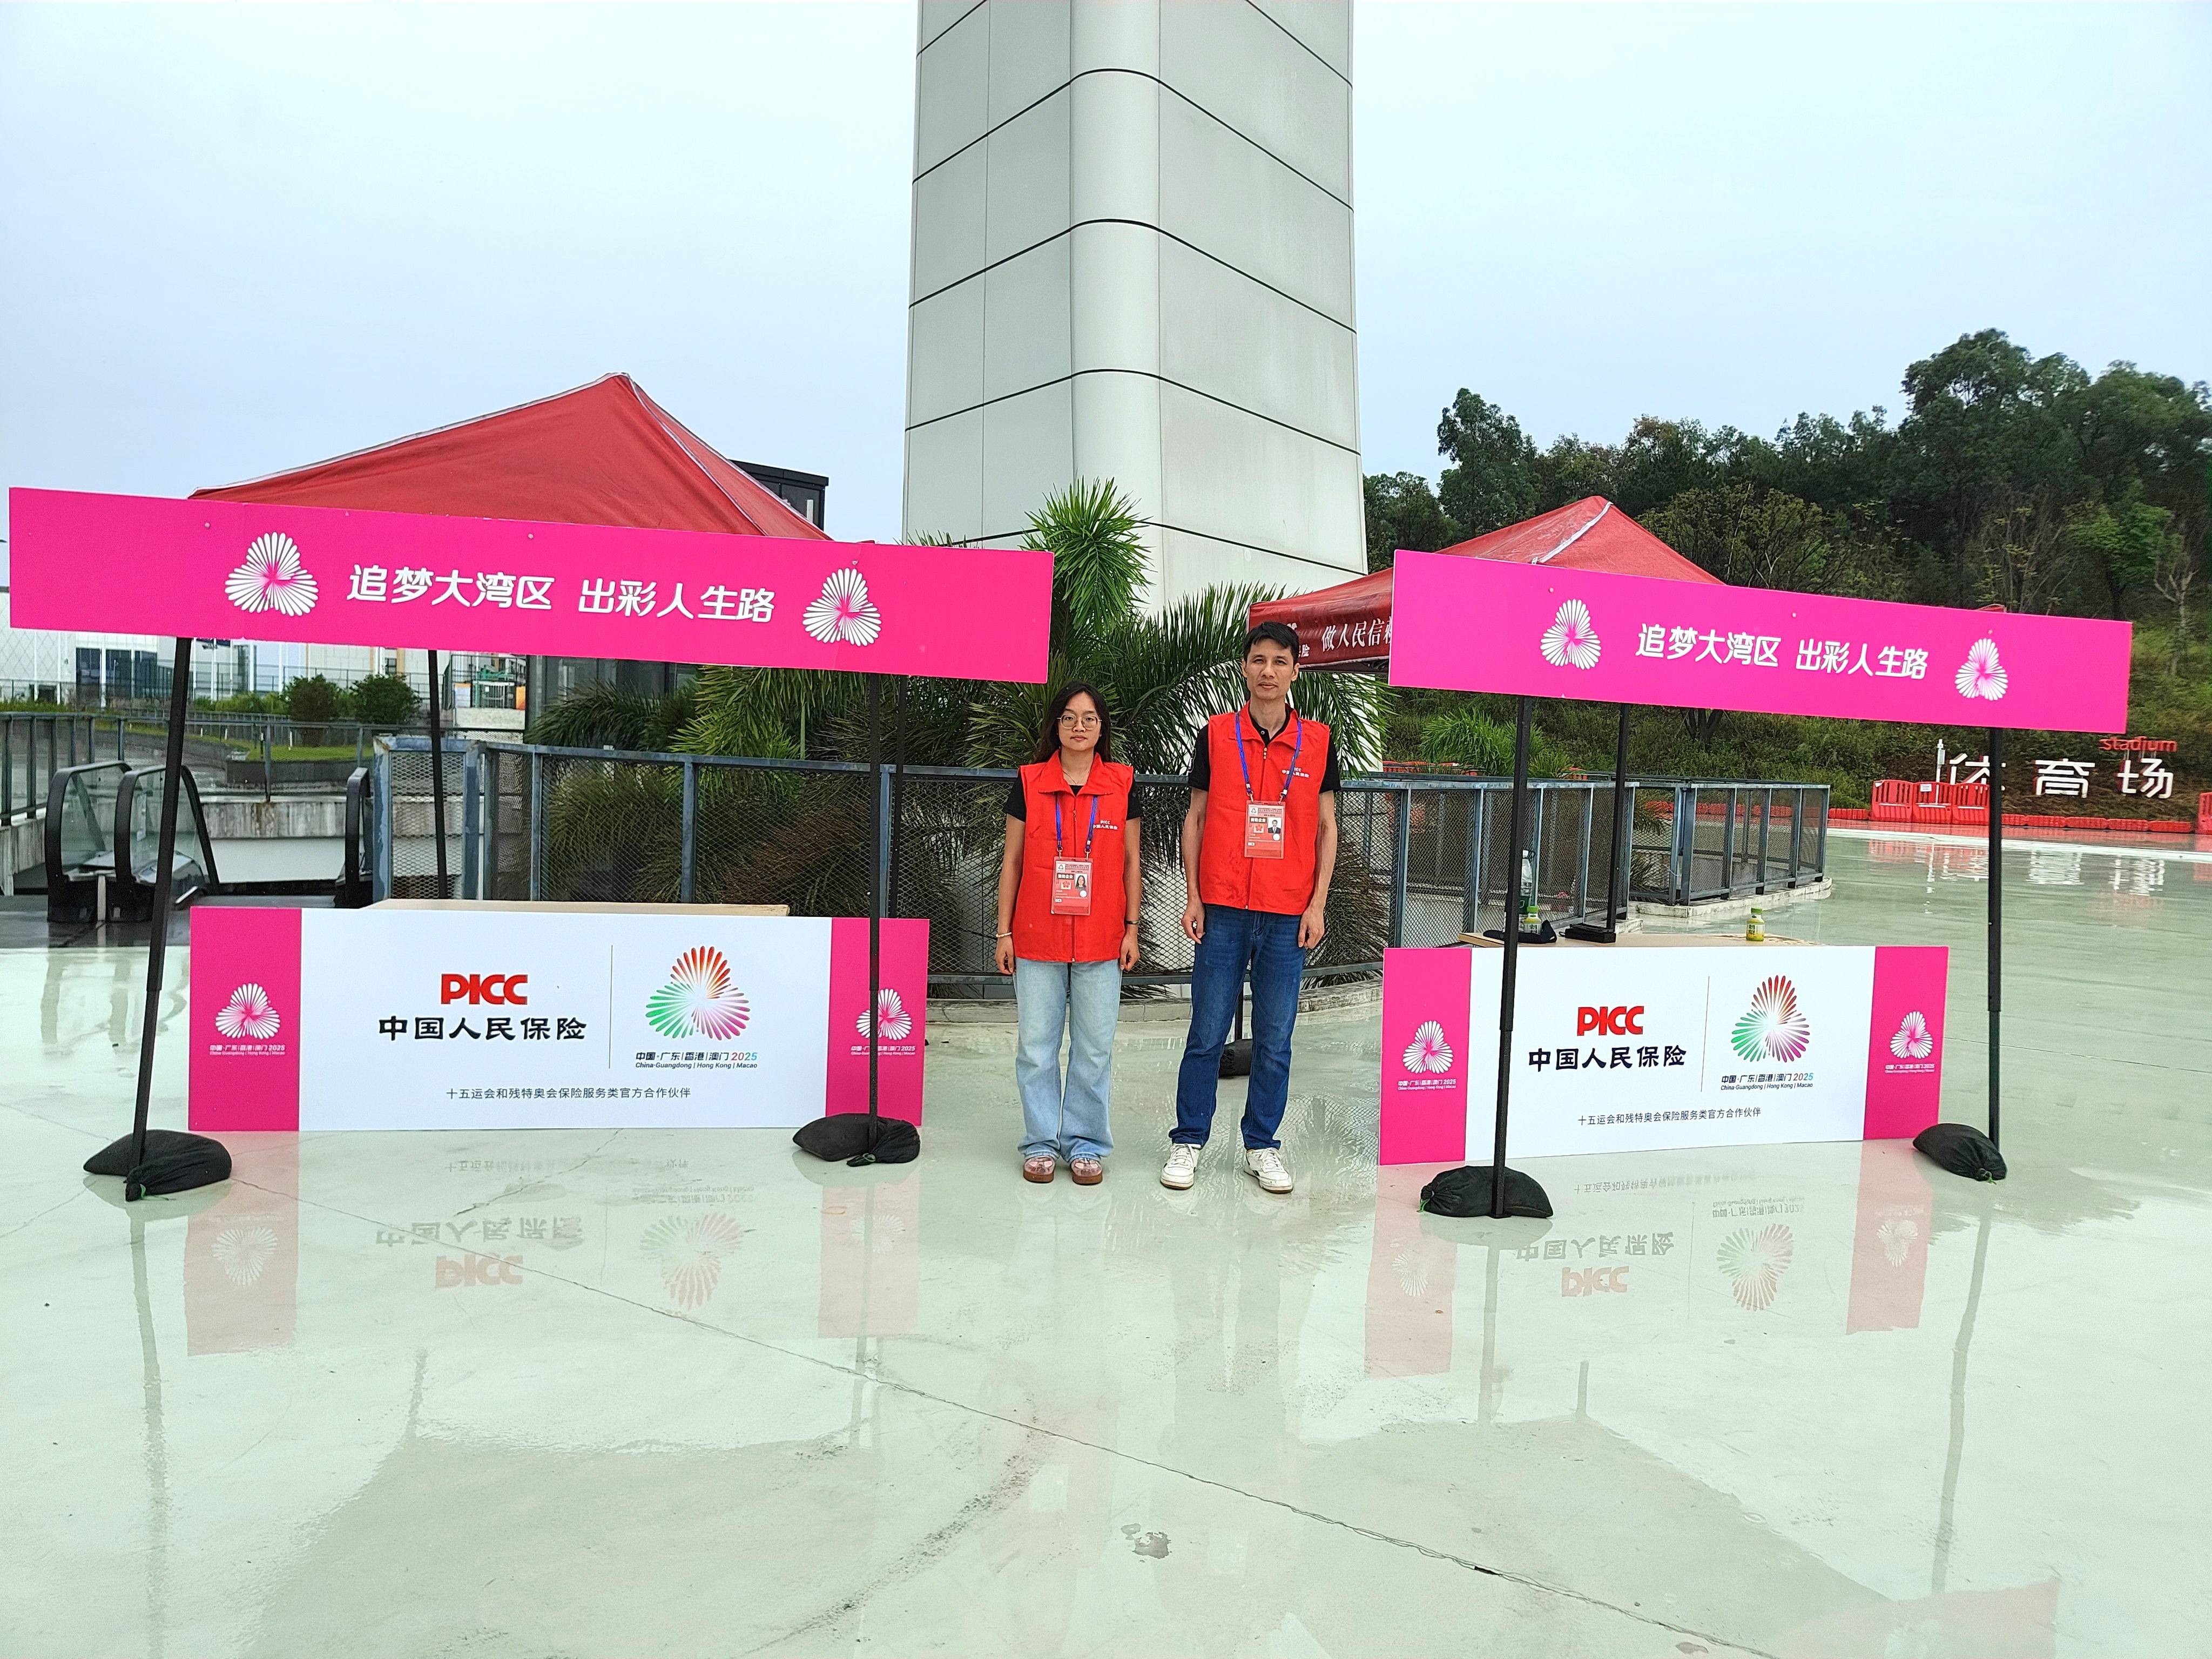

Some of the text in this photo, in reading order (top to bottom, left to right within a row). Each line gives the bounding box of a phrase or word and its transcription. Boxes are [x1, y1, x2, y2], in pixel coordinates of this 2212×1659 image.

[347, 564, 775, 623] 追梦大湾区 出彩人生路
[1635, 623, 1928, 679] 追梦大湾区 出彩人生路
[2099, 736, 2177, 752] stadium
[441, 974, 528, 1005] PICC
[379, 1015, 587, 1041] 中国人民保险
[1577, 1006, 1644, 1036] PICC
[731, 1052, 757, 1061] 2025
[1528, 1044, 1687, 1073] 中国人民保险
[1793, 1073, 1814, 1081] 2025
[446, 1087, 691, 1100] 十五运会和残特奥会保险服务类官方合作伙伴
[1577, 1107, 1761, 1126] 十五运会和残特奥会保险服务类官方合作伙伴
